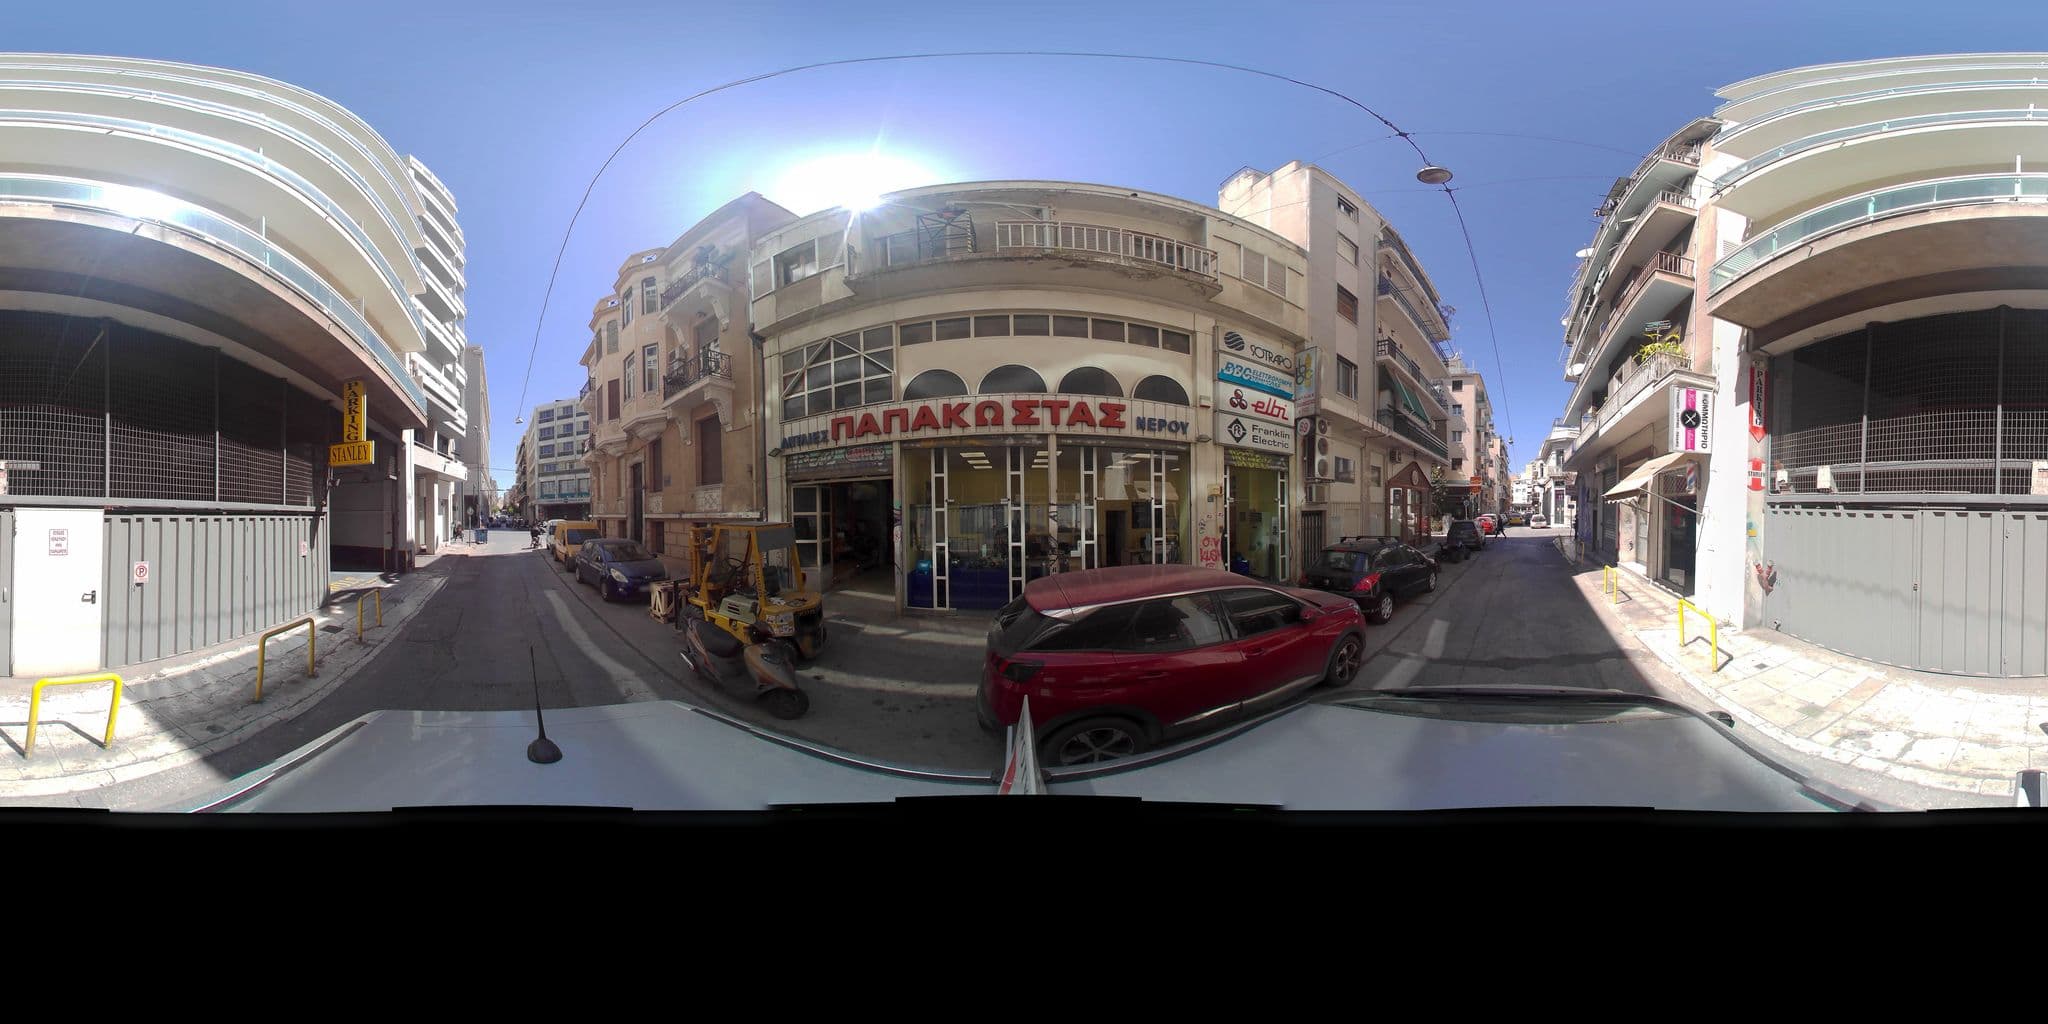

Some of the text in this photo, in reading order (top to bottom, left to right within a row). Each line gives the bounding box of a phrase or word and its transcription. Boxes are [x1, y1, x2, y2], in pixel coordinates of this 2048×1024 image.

[1251, 397, 1288, 420] elbi
[1755, 370, 1763, 426] PARKING
[346, 382, 360, 441] PARKING
[831, 400, 1126, 440] ΠΑΠΑΚΩΣΤΑΣ
[1136, 416, 1190, 435] ΝΕΡΟΥ
[1252, 424, 1290, 439] Franklin
[1252, 435, 1289, 448] Electric
[332, 444, 368, 462] STANLEY
